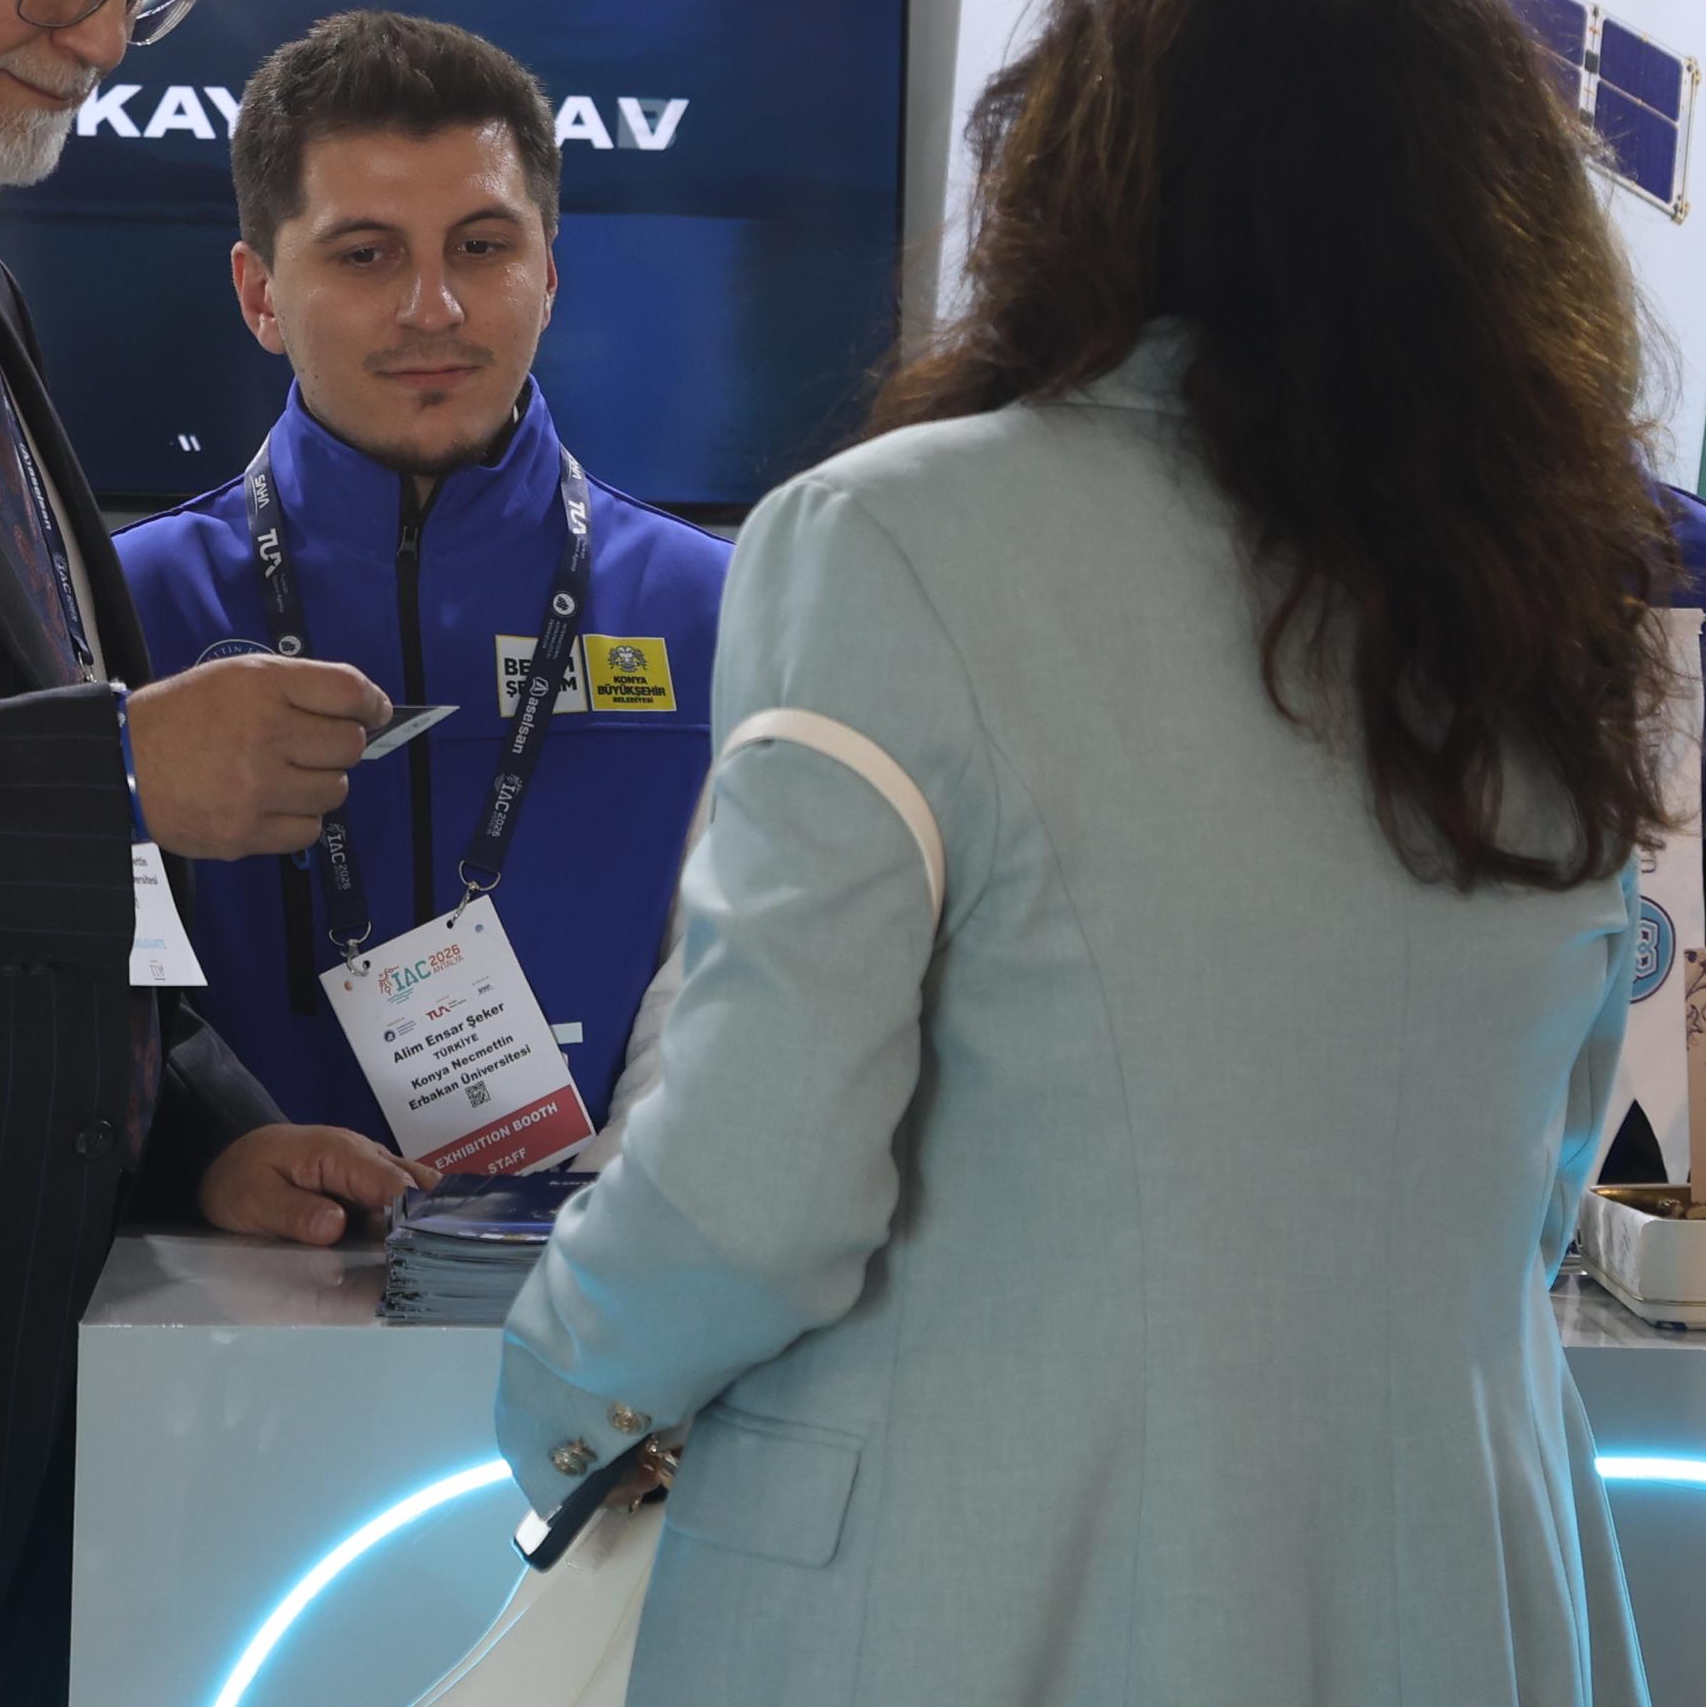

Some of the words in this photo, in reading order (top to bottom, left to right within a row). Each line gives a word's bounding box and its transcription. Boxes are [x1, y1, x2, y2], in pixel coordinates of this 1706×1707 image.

[613, 676, 647, 685] KONYA
[512, 697, 540, 755] aselsan
[391, 960, 432, 992] IAC
[428, 944, 462, 966] 2026
[393, 1042, 425, 1064] Alim
[425, 1021, 465, 1047] Ensar
[465, 1001, 506, 1029] Şeker
[425, 1005, 451, 1022] TUA
[411, 1066, 451, 1091] Konya
[451, 1033, 515, 1071] Necmettin
[433, 1032, 480, 1061] TÜRKİYE
[408, 1080, 460, 1112] Erbakan
[460, 1043, 532, 1086] Üniversitesi
[434, 1125, 511, 1171] EXHIBITION
[512, 1101, 559, 1131] BOOTH
[487, 1147, 528, 1175] STAFF
